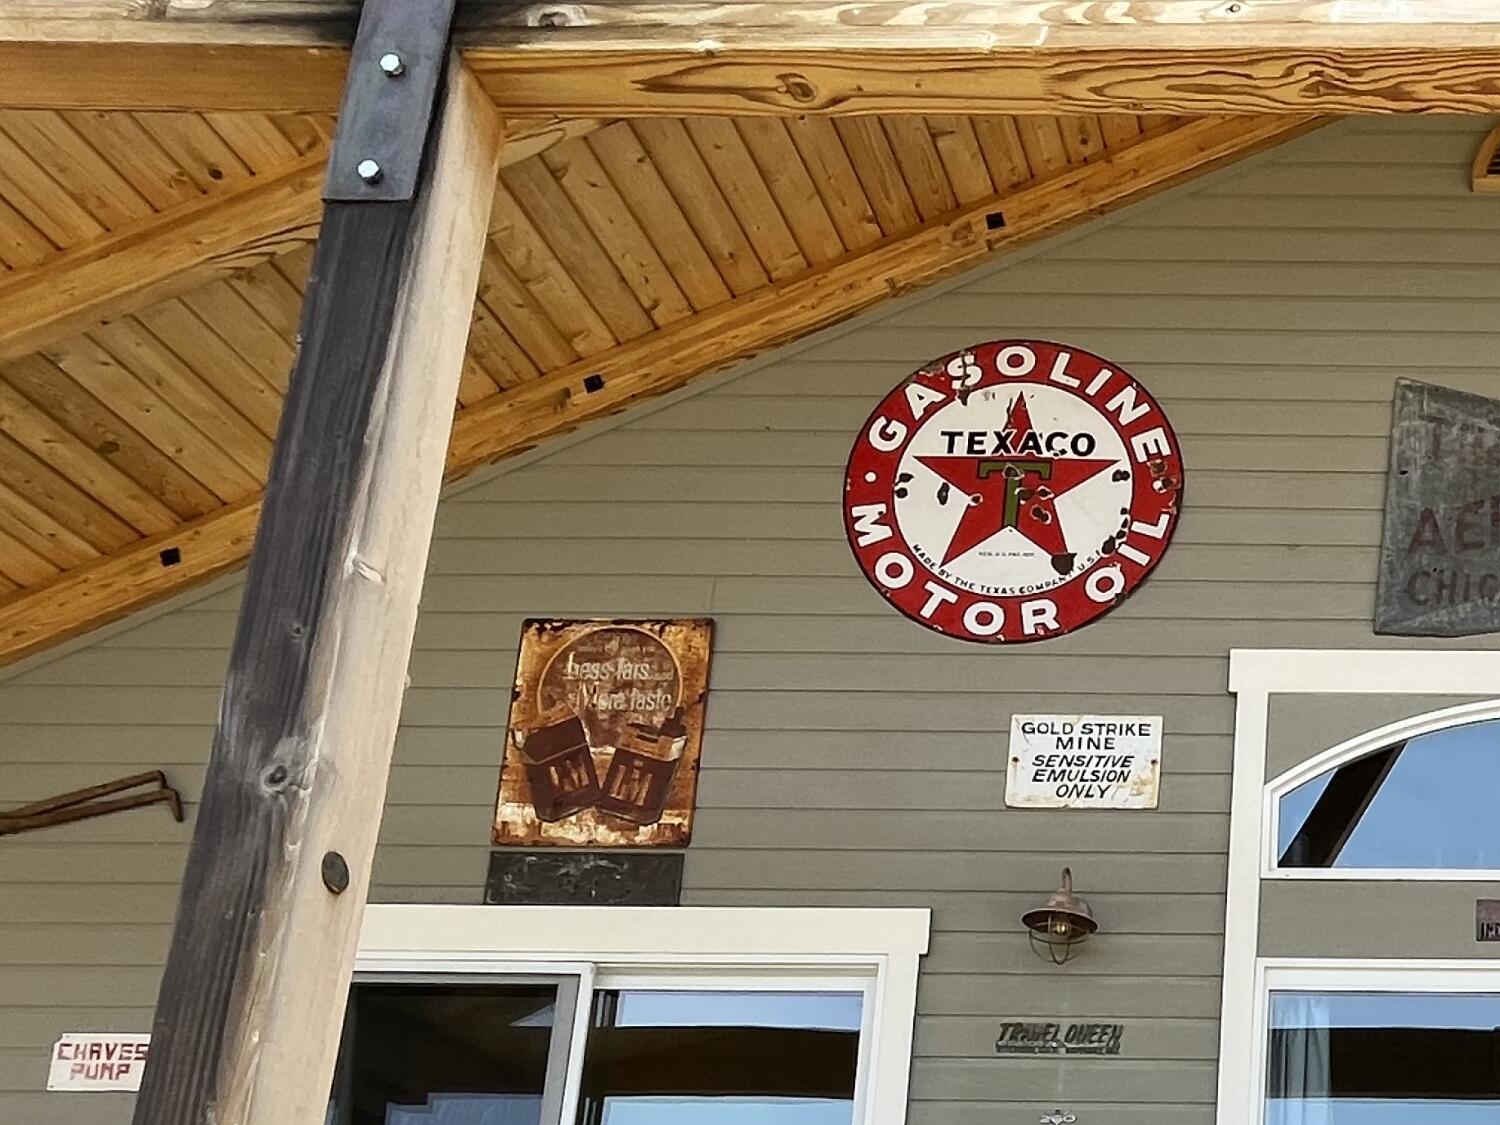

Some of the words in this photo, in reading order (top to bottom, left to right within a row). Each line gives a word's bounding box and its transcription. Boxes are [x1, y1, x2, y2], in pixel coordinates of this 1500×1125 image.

[868, 345, 1172, 464] GASOLINE
[940, 431, 1096, 457] TEXACO
[851, 503, 1061, 636] MOTOR
[1085, 512, 1170, 604] OIL
[912, 544, 938, 570] MADE
[938, 568, 953, 580] BY
[954, 576, 975, 591] THE
[979, 585, 1015, 595] TEXAS
[1021, 721, 1074, 735] GOLD
[1080, 723, 1152, 737] STRIKE
[1055, 737, 1116, 750] MINE
[1032, 755, 1135, 768] SENSITIVE
[1031, 769, 1131, 783] EMULSION
[1055, 784, 1111, 799] ONLY
[57, 1043, 149, 1061] CHAVES
[70, 1063, 131, 1080] PUMP
